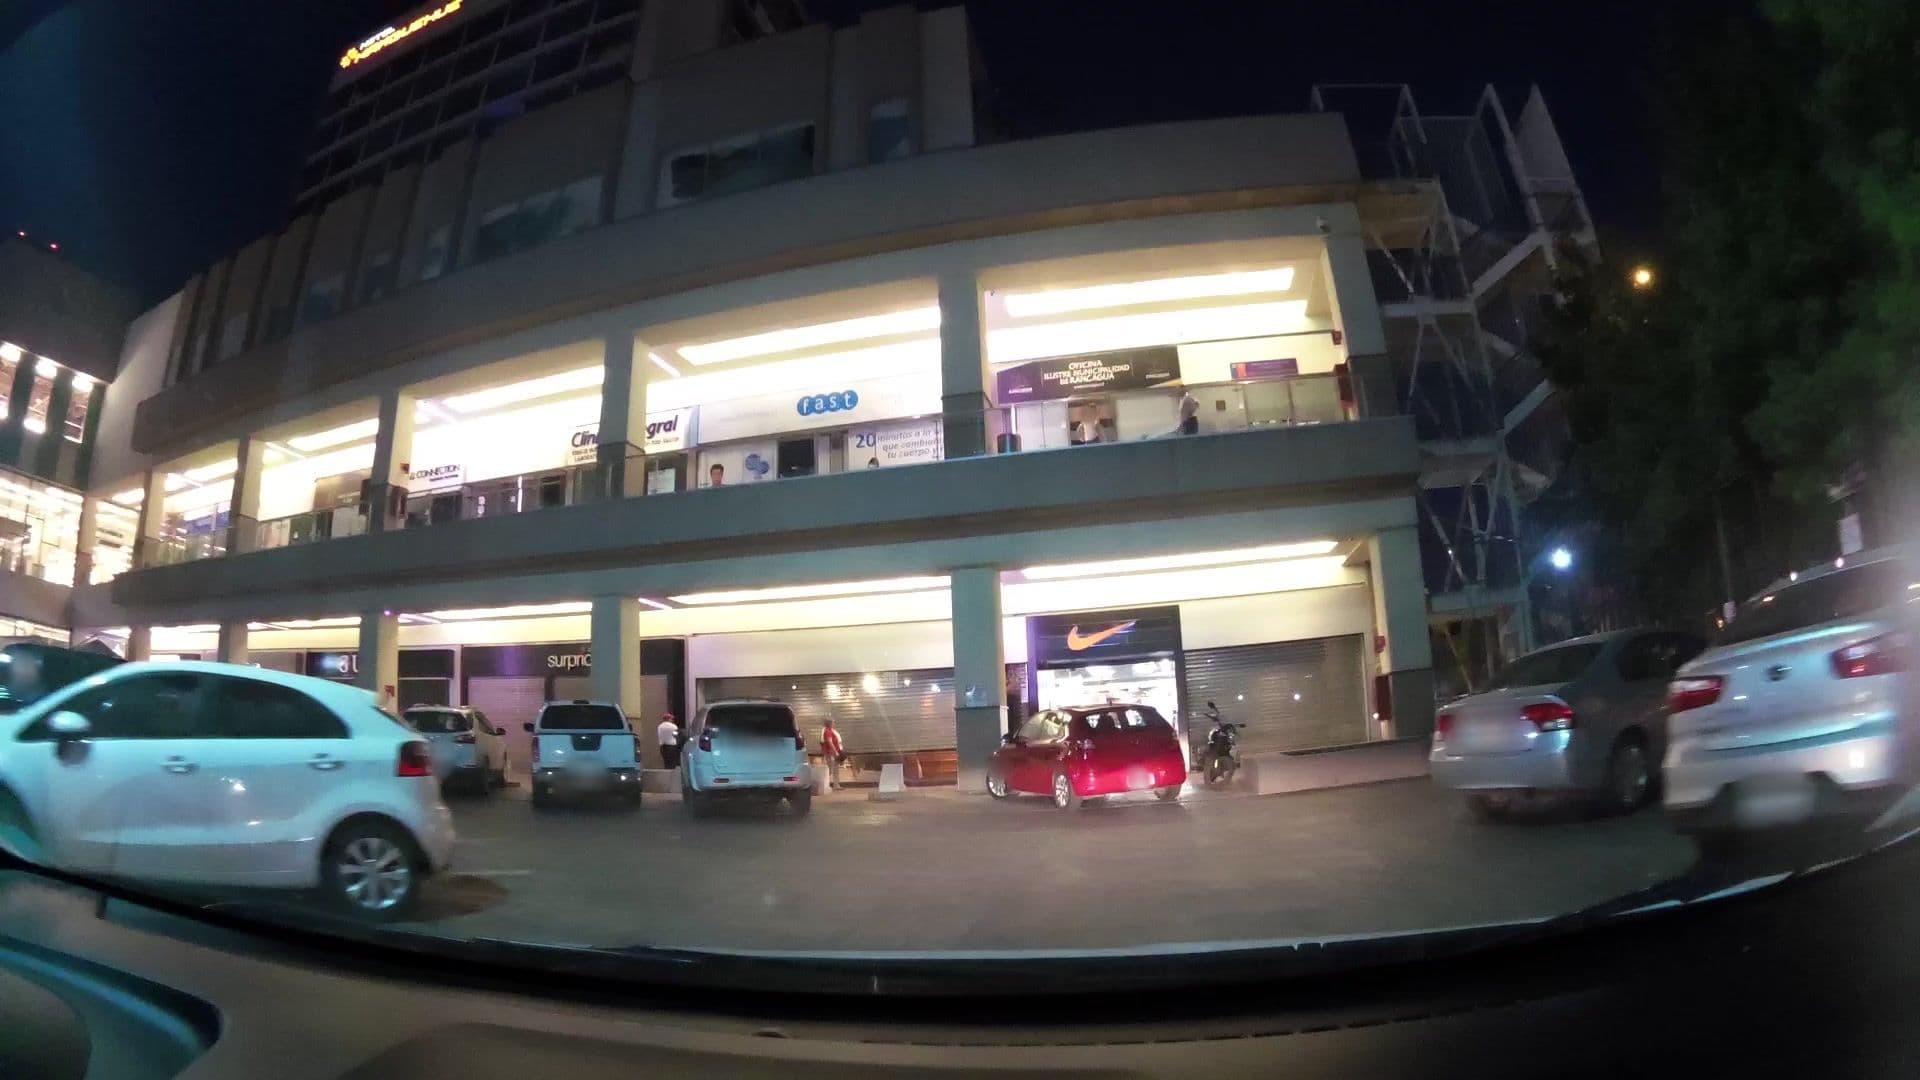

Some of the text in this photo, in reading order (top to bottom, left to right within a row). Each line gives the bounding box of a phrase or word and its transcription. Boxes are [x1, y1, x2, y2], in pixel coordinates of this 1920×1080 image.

[1068, 359, 1103, 370] OFICINA
[645, 414, 679, 439] gral
[855, 433, 875, 448] 20
